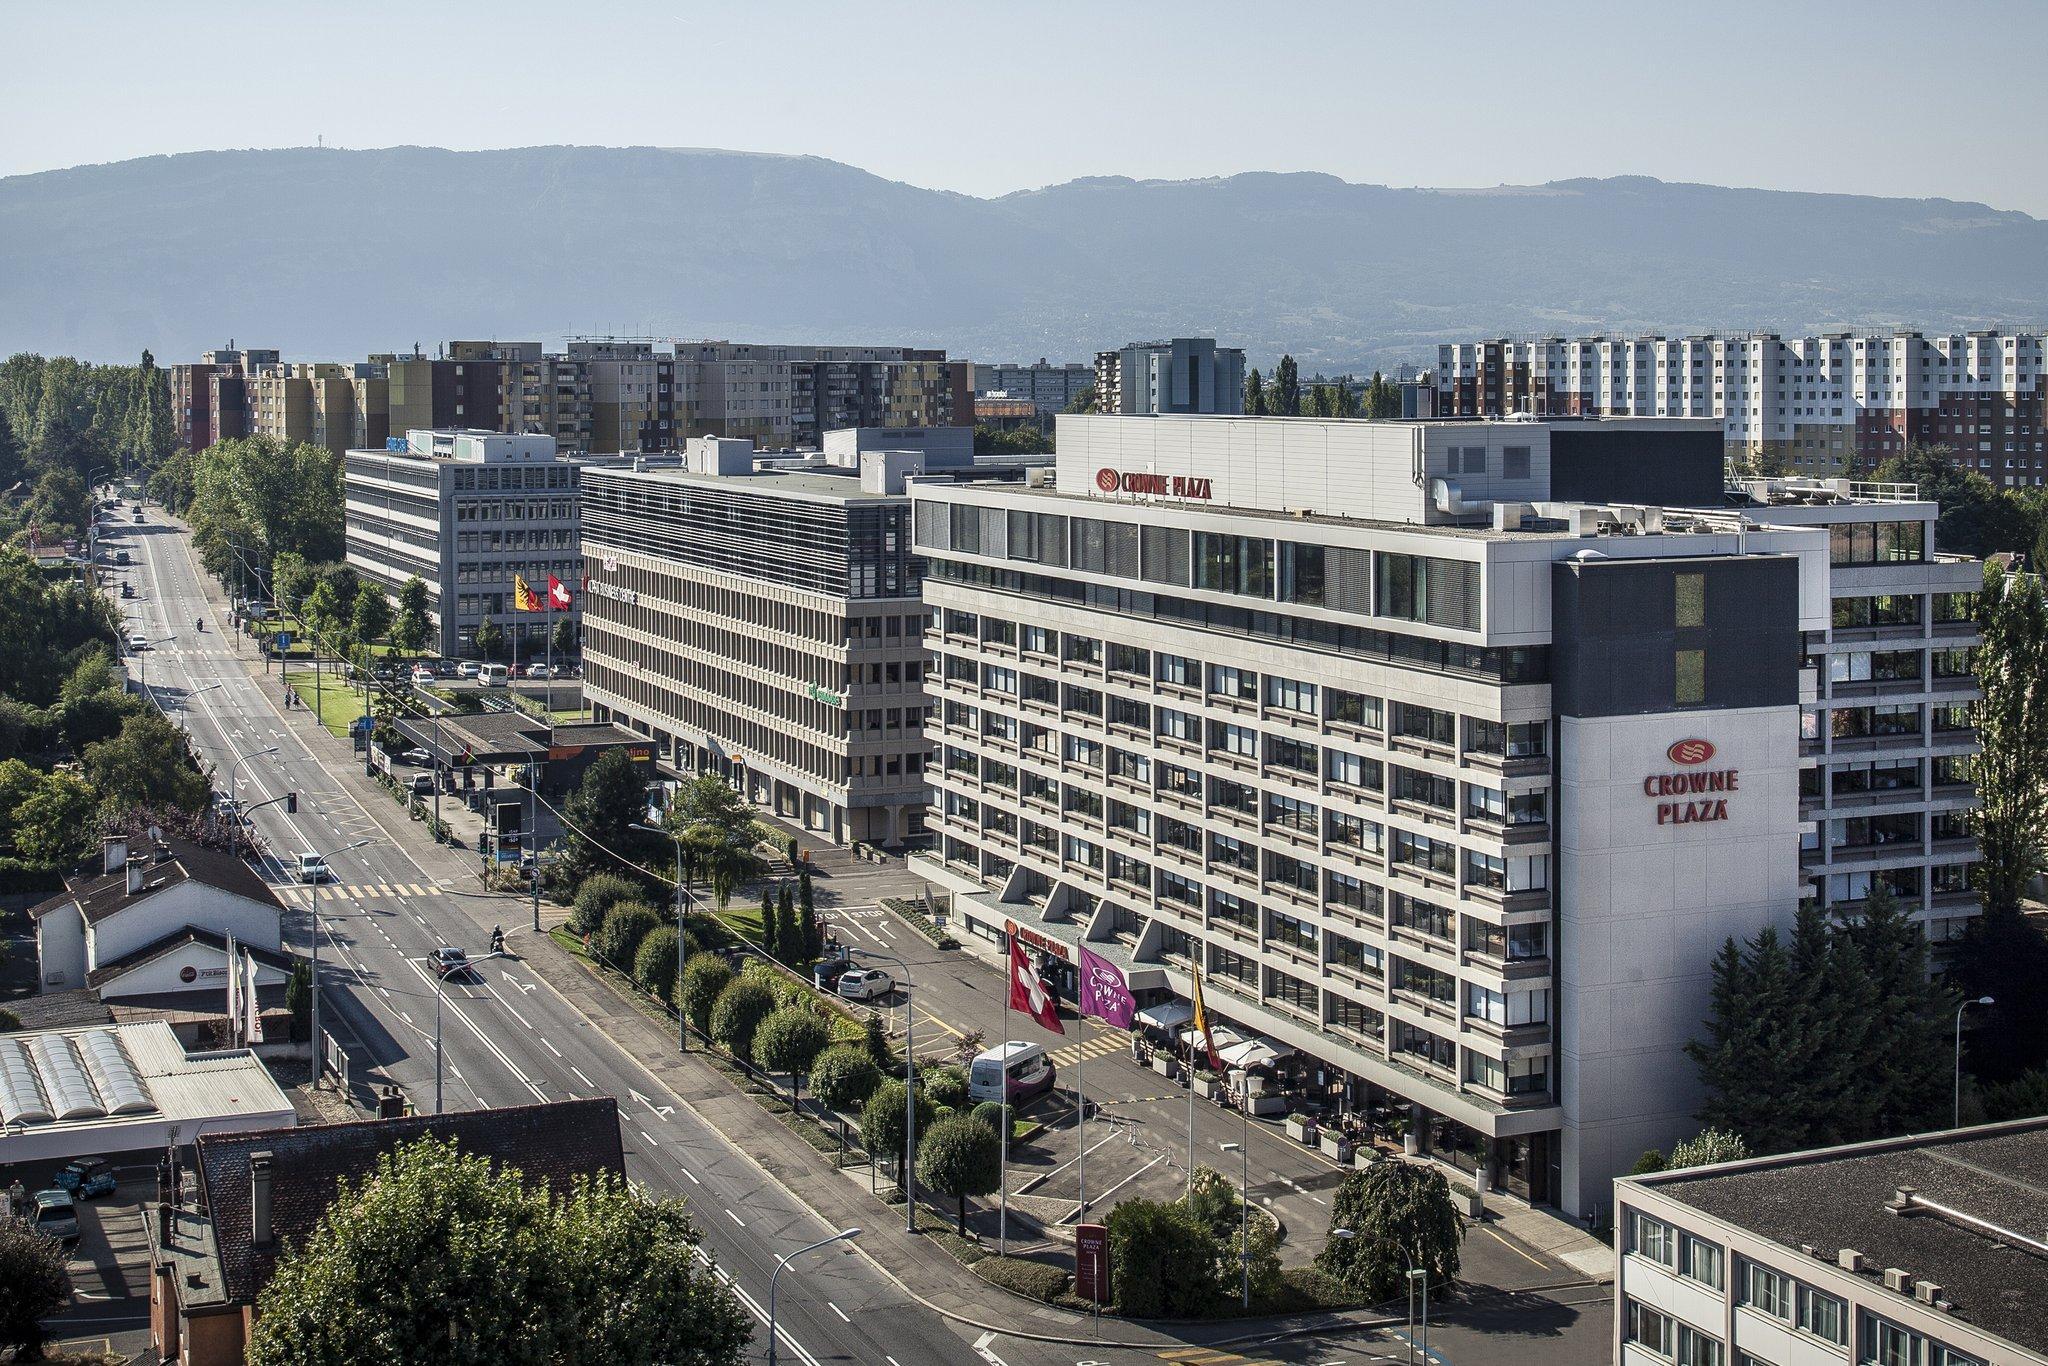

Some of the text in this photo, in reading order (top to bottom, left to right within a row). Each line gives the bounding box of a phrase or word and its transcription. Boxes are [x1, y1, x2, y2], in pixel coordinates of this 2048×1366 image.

[1121, 472, 1213, 500] CROWNE PLAZA
[1643, 769, 1739, 797] CROWNE
[1657, 799, 1729, 825] PLAZA
[850, 910, 885, 918] STOP
